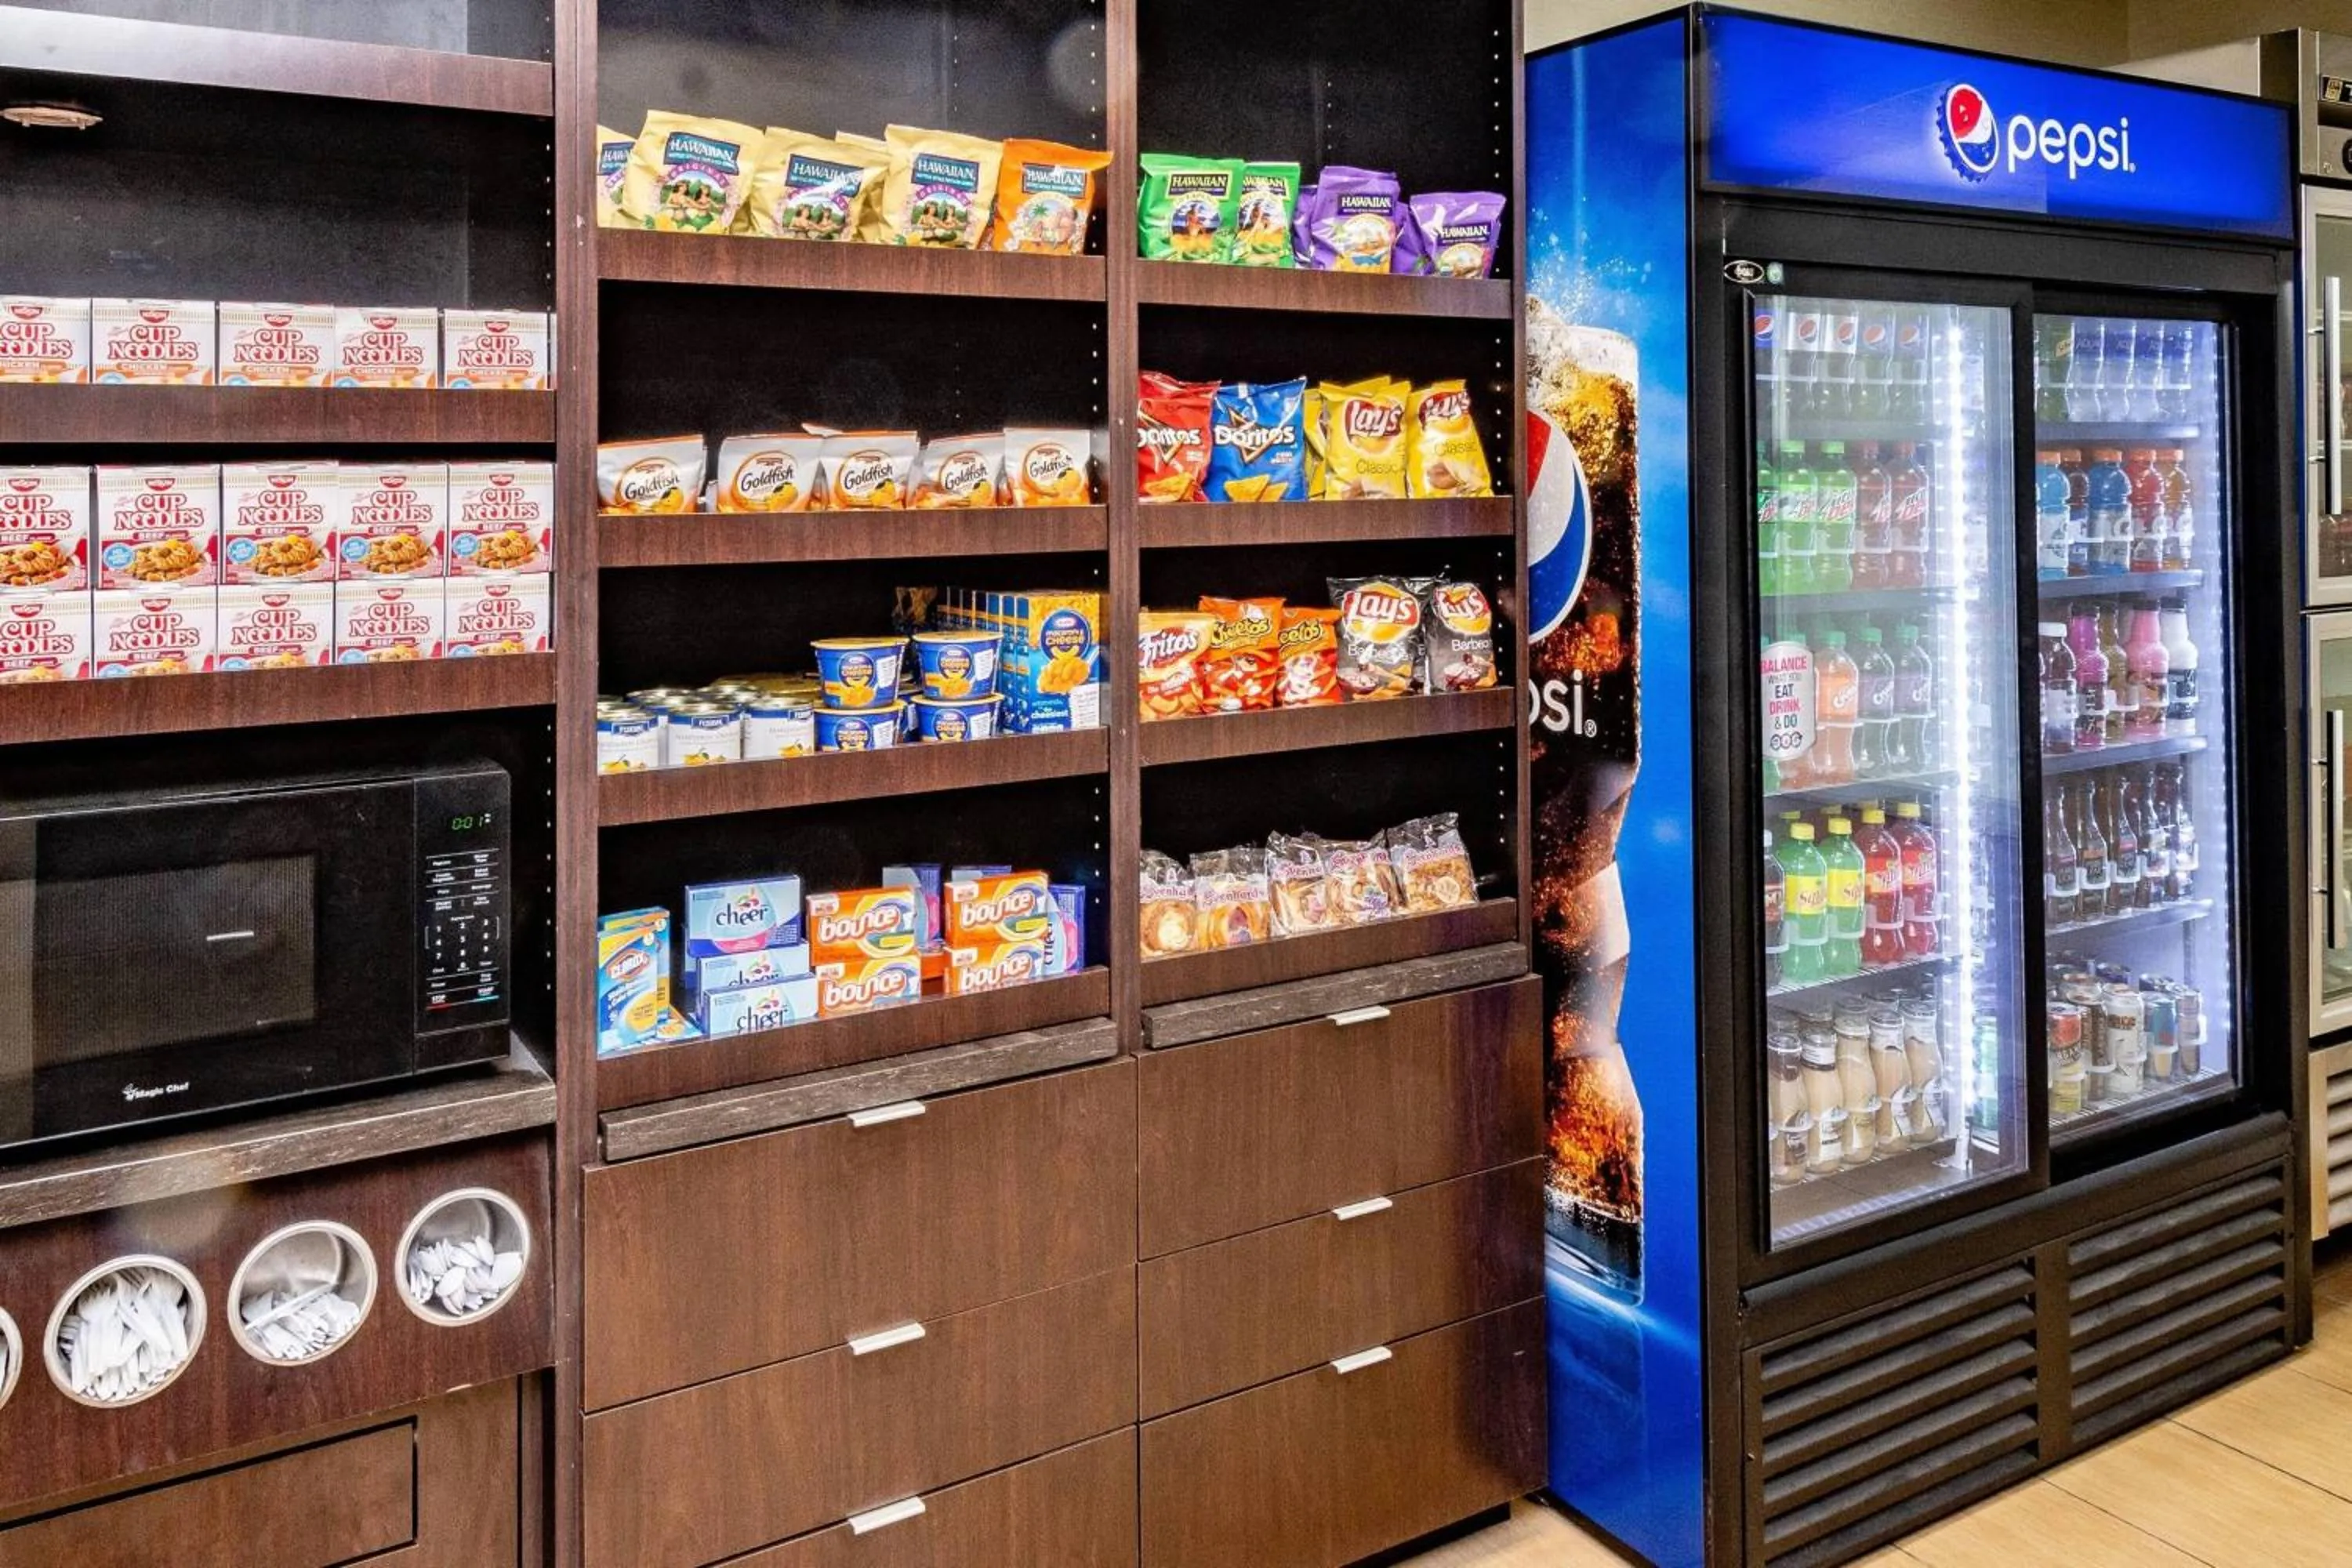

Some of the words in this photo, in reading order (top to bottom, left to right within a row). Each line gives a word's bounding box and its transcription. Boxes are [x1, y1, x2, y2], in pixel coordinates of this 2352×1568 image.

[670, 140, 735, 162] HAWAIIAN
[2008, 115, 2129, 179] pepsi
[918, 160, 975, 180] HAWAIIAN
[1026, 170, 1083, 186] HAWAIIAN
[1172, 176, 1227, 187] HAWAIIAN
[1341, 196, 1391, 209] HAWAIIAN
[1440, 225, 1490, 238] HAWAIIAN
[1, 323, 54, 340] CUP
[130, 325, 181, 343] CUP
[254, 330, 303, 347] CUP
[362, 332, 408, 349] CUP
[0, 339, 72, 358] OODLES
[108, 341, 198, 361] NOODLES
[476, 336, 520, 352] CUP
[234, 345, 320, 365] NOODLES
[343, 347, 424, 365] NOODLES
[458, 350, 533, 367] NOODLES
[1214, 424, 1295, 445] Doritos
[624, 472, 681, 500] Goldfish
[740, 465, 795, 492] Goldfish
[844, 463, 894, 490] Goldfish
[945, 465, 988, 490] Goldfish
[2, 495, 53, 512] CUP
[136, 494, 187, 511] CUP
[259, 491, 307, 509] CUP
[372, 491, 416, 508] CUP
[481, 488, 524, 506] CUP
[0, 510, 72, 530] OODLES
[114, 509, 204, 530] NOODLES
[239, 506, 323, 524] NOODLES
[351, 506, 433, 524] NOODLES
[463, 504, 539, 521] NOODLES
[368, 602, 414, 620] CUP
[477, 598, 521, 616] CUP
[132, 613, 182, 633] CUP
[252, 609, 301, 627] CUP
[349, 616, 430, 637] NOODLES
[459, 612, 535, 633] NOODLES
[2, 619, 55, 638] CUP
[232, 623, 317, 646] NOODLES
[1279, 620, 1322, 644] eetos
[0, 634, 74, 655] OODLES
[110, 628, 200, 652] NOODLES
[1138, 627, 1199, 666] Fritos
[1761, 655, 1807, 673] BALANCE
[1774, 684, 1794, 699] EAT
[1769, 699, 1801, 715] DRINK
[1784, 713, 1798, 728] DO
[716, 904, 768, 926] cheer
[960, 889, 1036, 927] bounce
[819, 906, 899, 942] bounce
[960, 952, 1033, 991] bounce
[825, 970, 906, 1006] bounce
[736, 1007, 788, 1031] cheer
